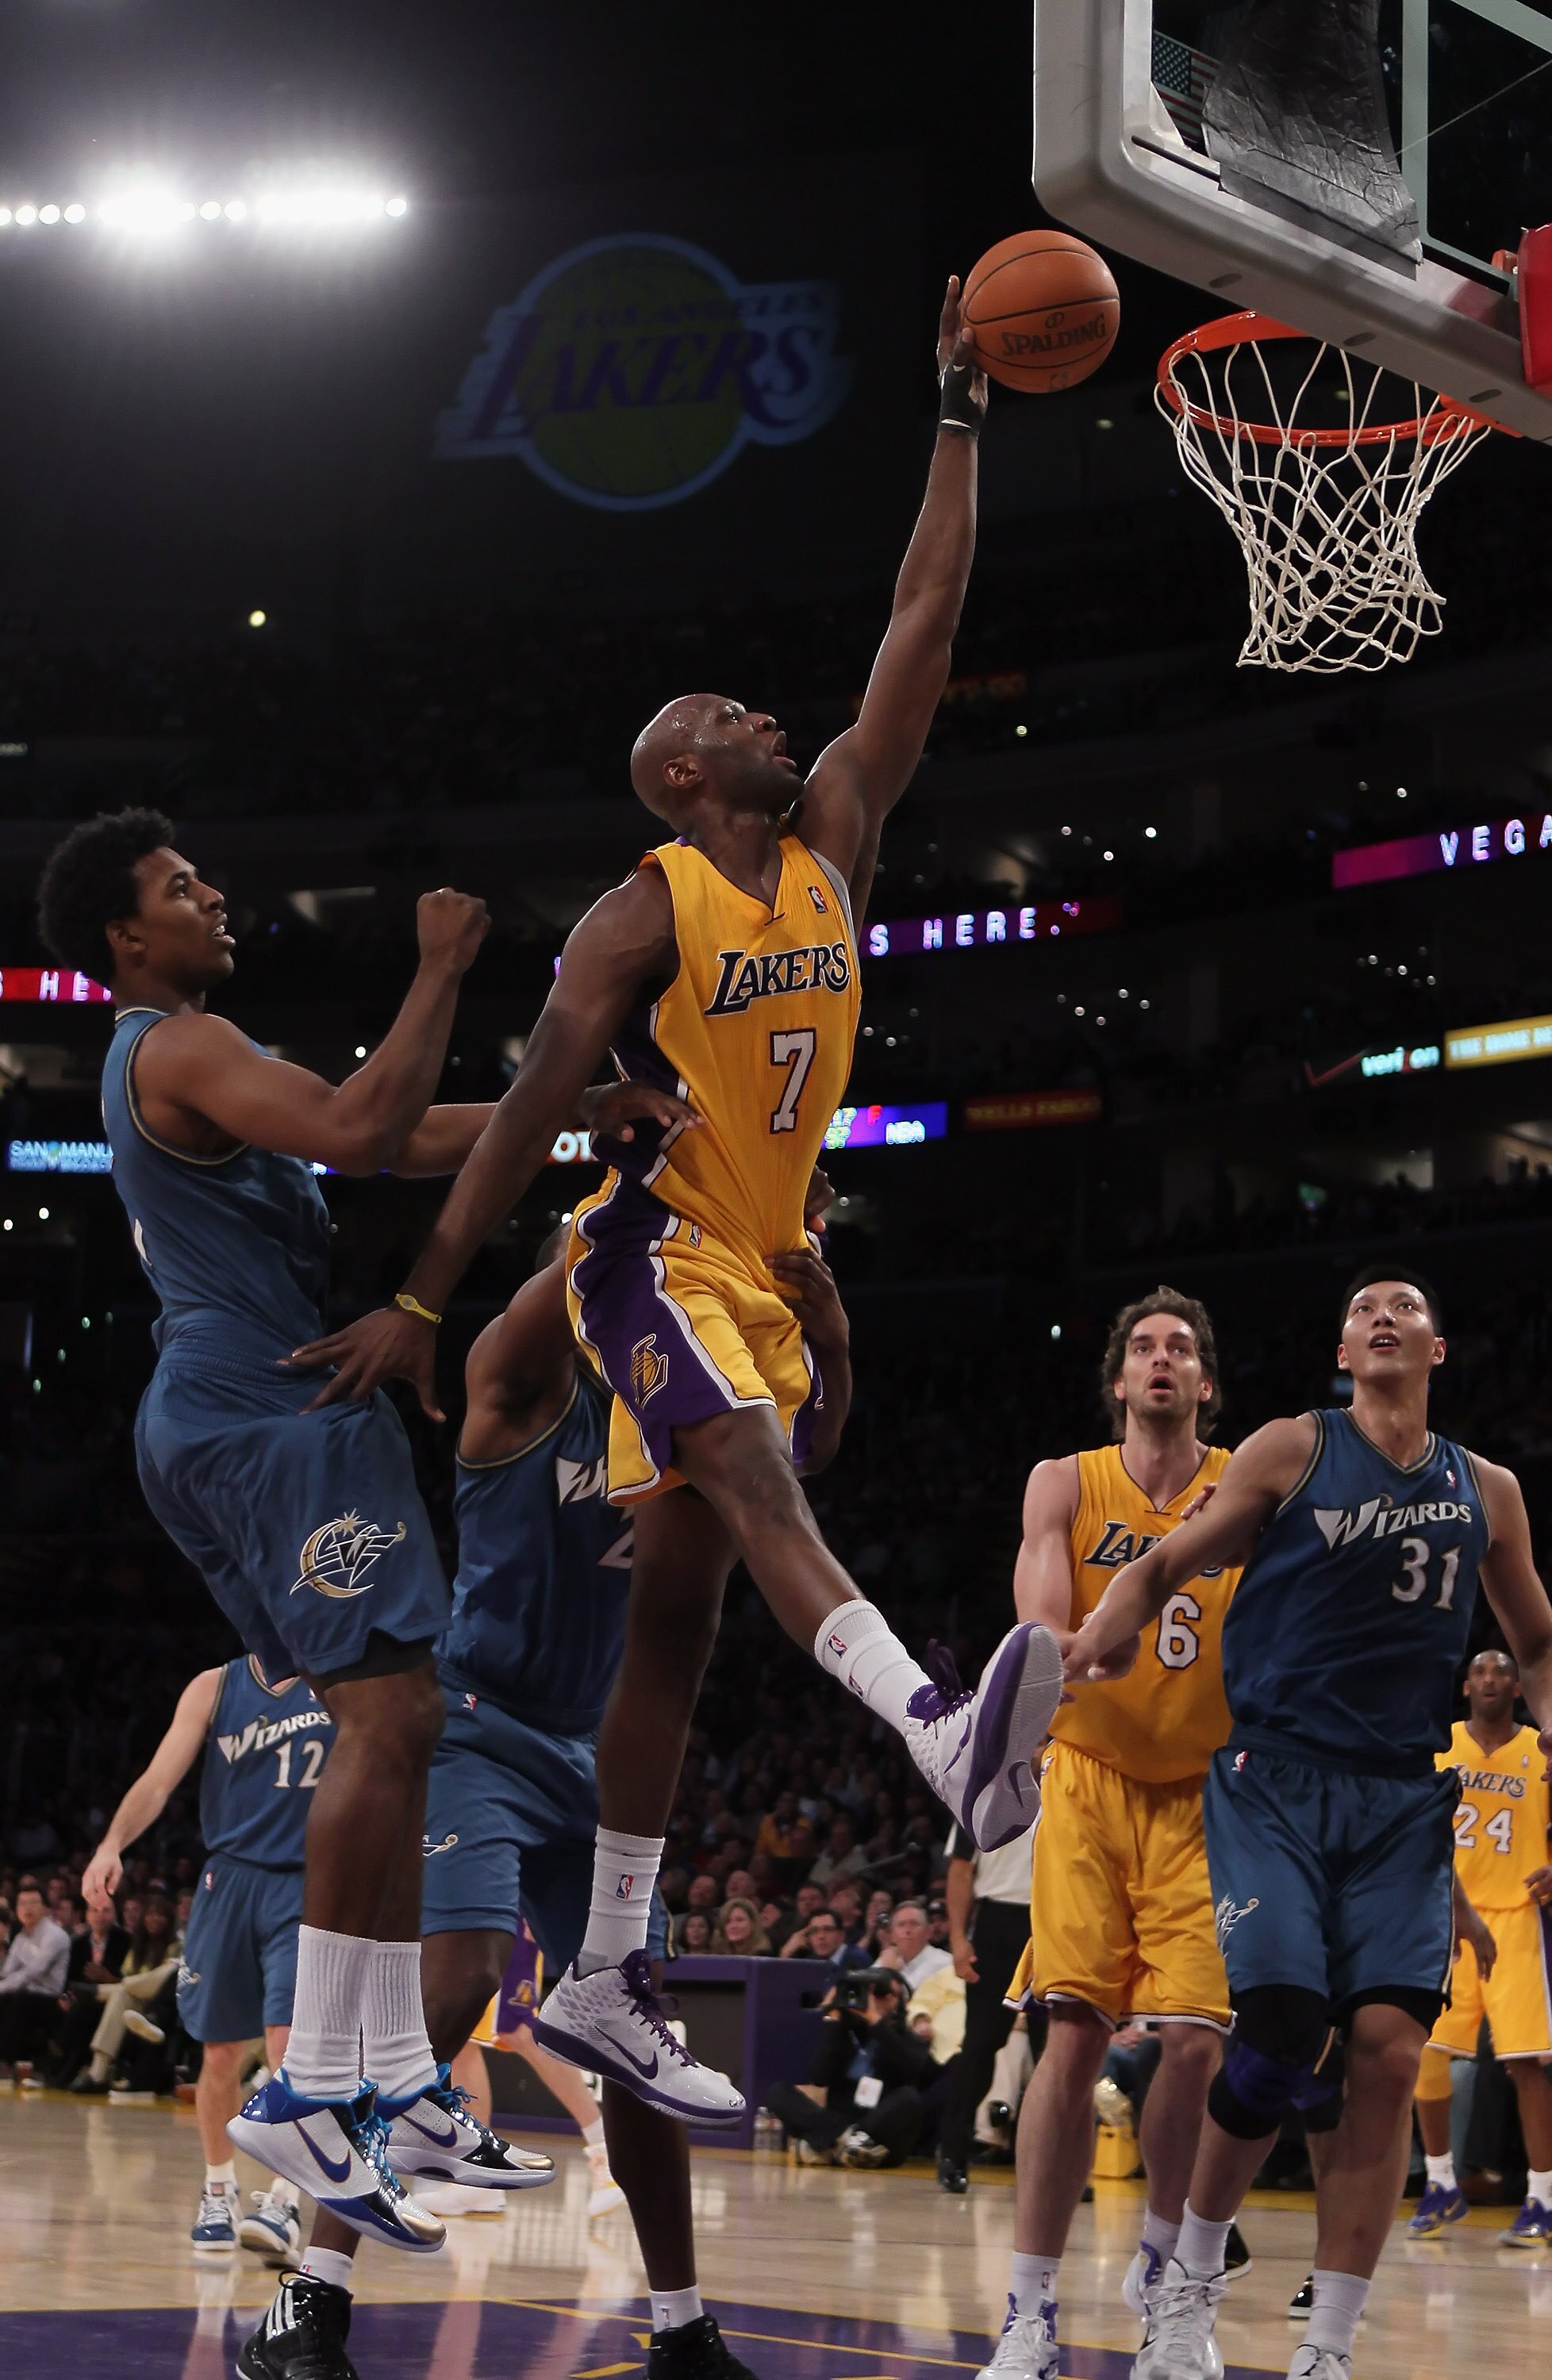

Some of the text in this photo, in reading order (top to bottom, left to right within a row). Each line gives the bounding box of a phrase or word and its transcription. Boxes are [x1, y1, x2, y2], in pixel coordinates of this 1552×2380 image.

[1001, 313, 1106, 356] SPALDING
[459, 313, 825, 441] LAKERS
[704, 941, 850, 1016] LAKERS
[770, 1027, 816, 1134] 7
[10, 1140, 48, 1157] SAN
[1313, 1492, 1472, 1552] WIZARDS
[1391, 1536, 1462, 1611] 31
[217, 1710, 332, 1765] WIZARDS
[273, 1739, 325, 1788] 12
[1454, 1802, 1513, 1854] 24
